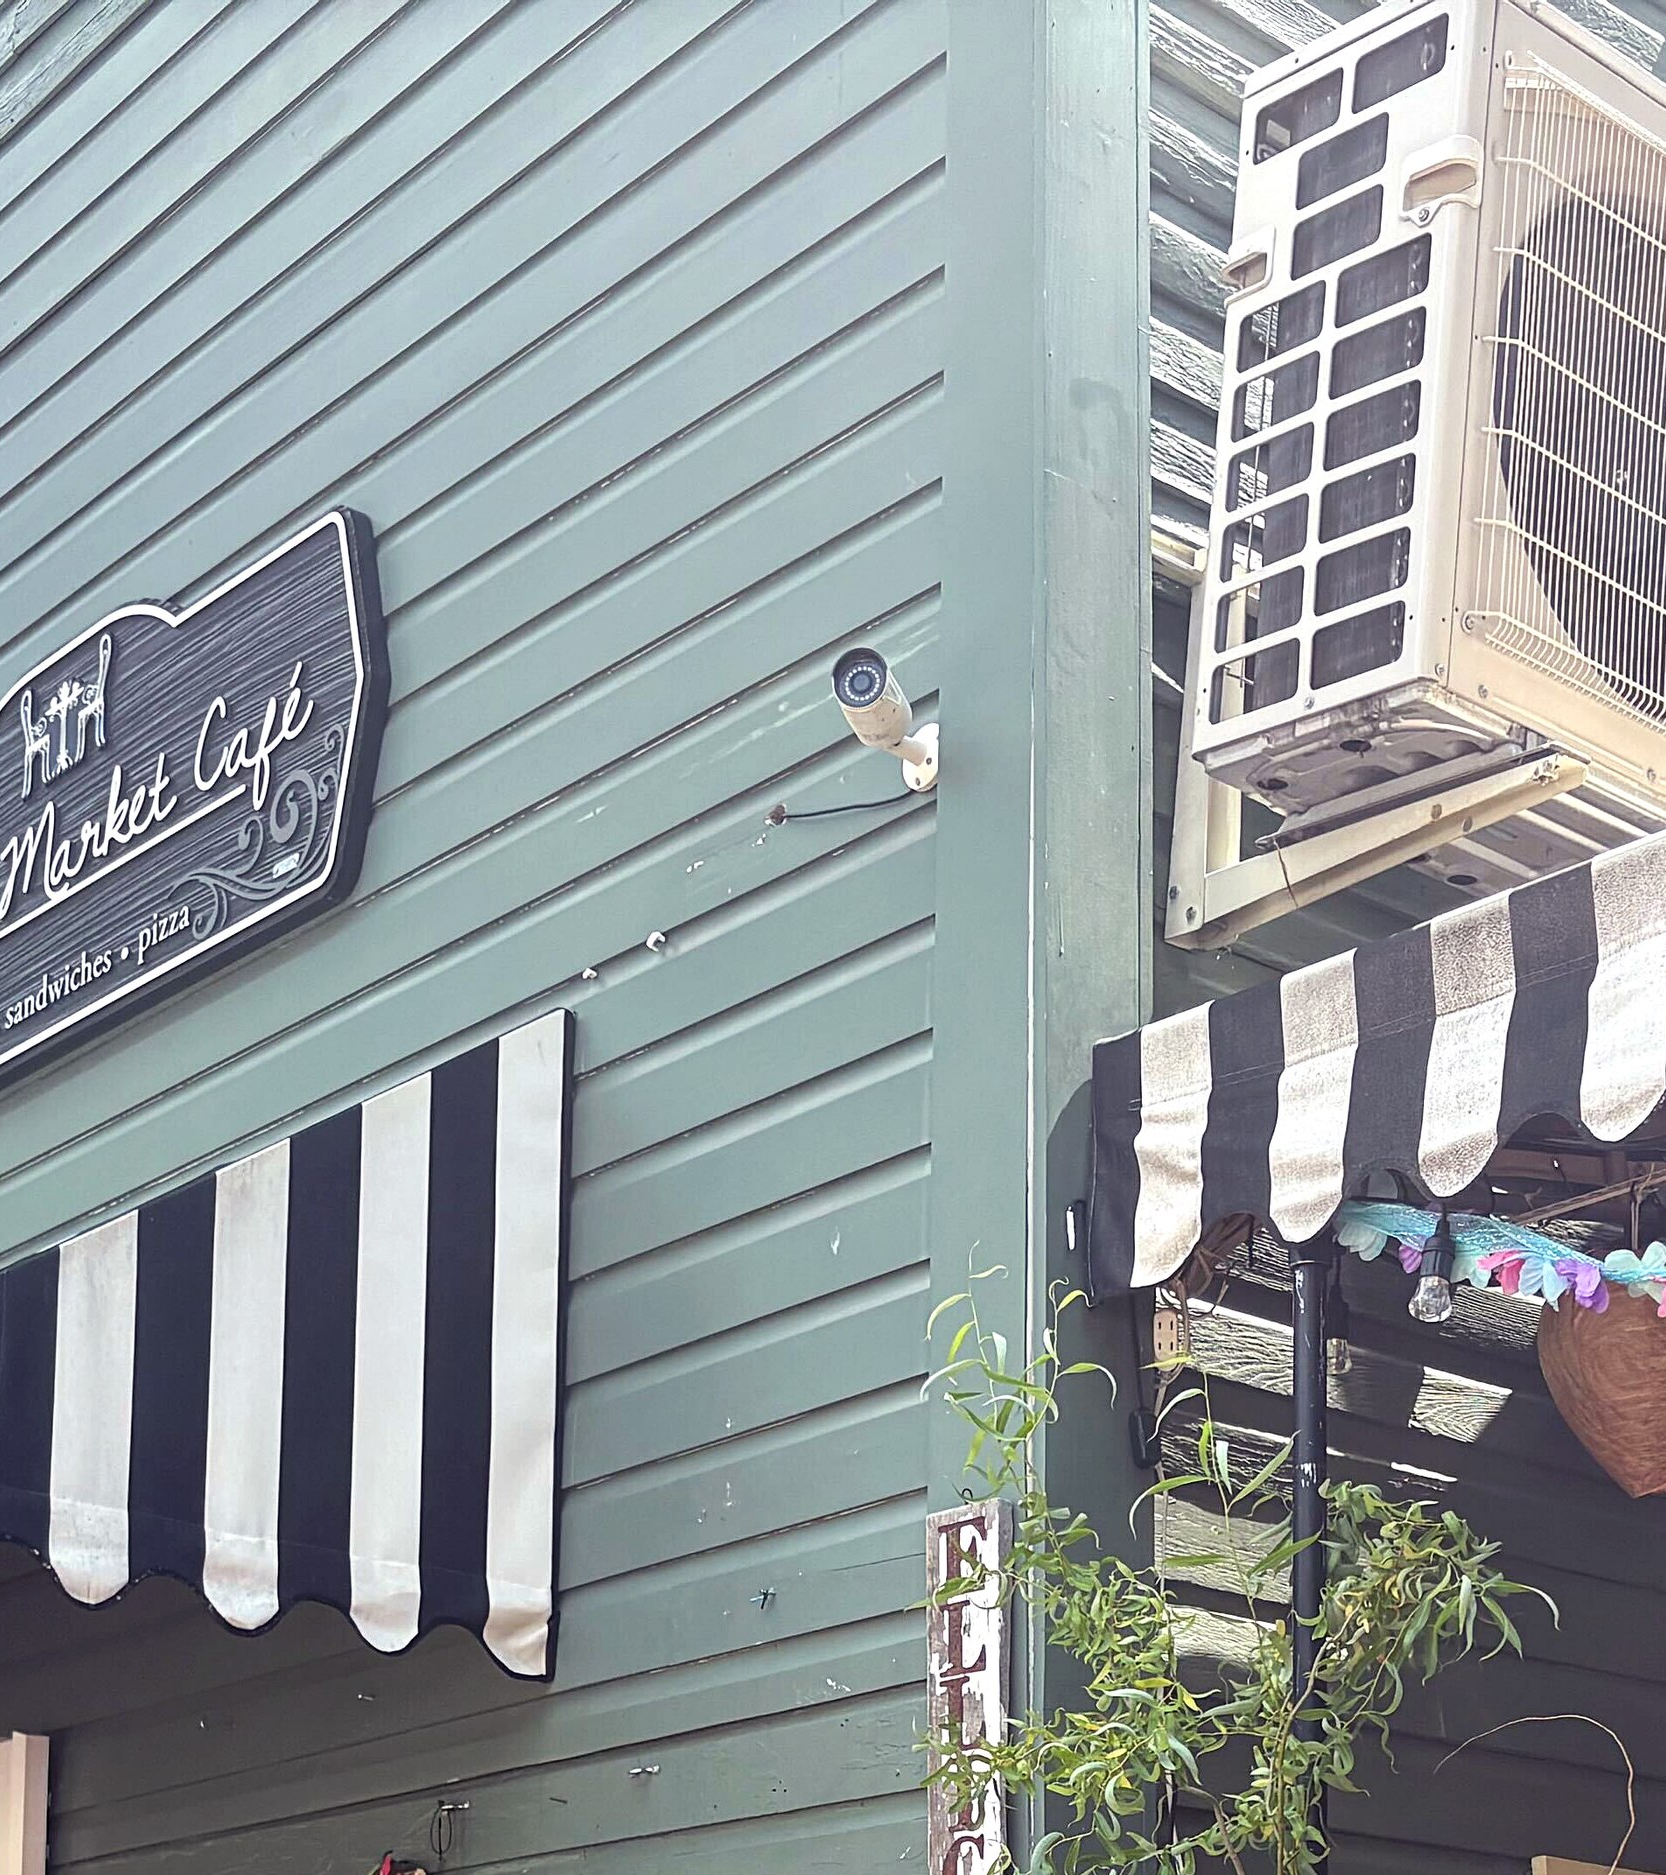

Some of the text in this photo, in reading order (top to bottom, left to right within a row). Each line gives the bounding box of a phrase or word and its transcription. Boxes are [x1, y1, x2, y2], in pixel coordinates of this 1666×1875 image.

[193, 660, 314, 811] Café
[3, 950, 112, 1030] sandwiches
[137, 905, 191, 966] pizza
